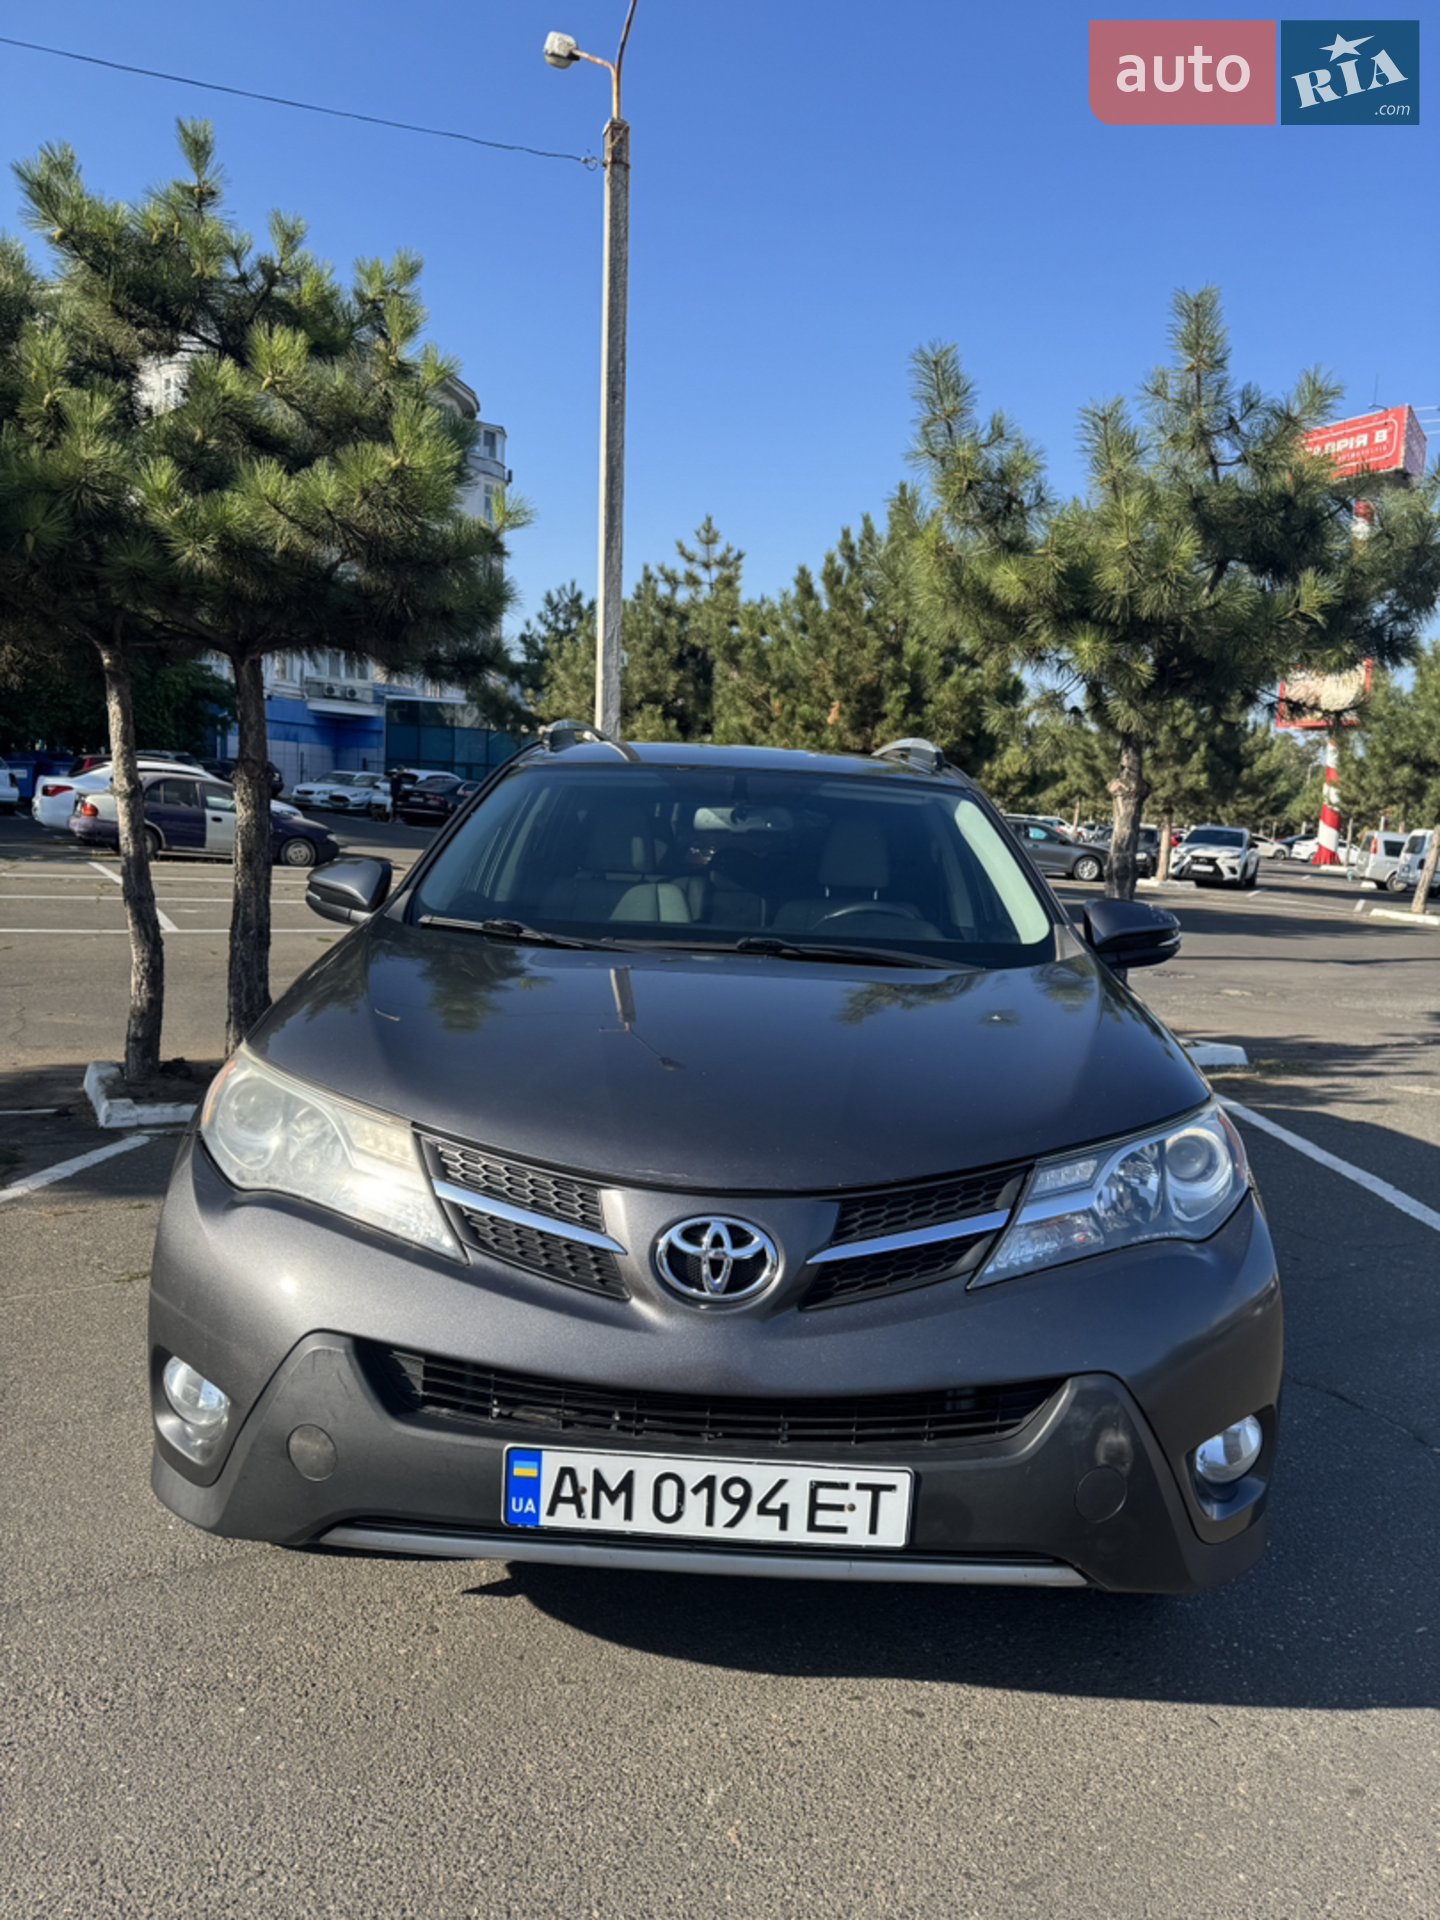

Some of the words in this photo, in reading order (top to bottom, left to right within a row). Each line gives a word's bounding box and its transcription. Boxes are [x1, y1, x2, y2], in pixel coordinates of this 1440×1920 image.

[511, 1496, 537, 1514] UA
[545, 1466, 635, 1522] AM
[651, 1471, 790, 1532] 0194
[806, 1480, 898, 1535] ET
